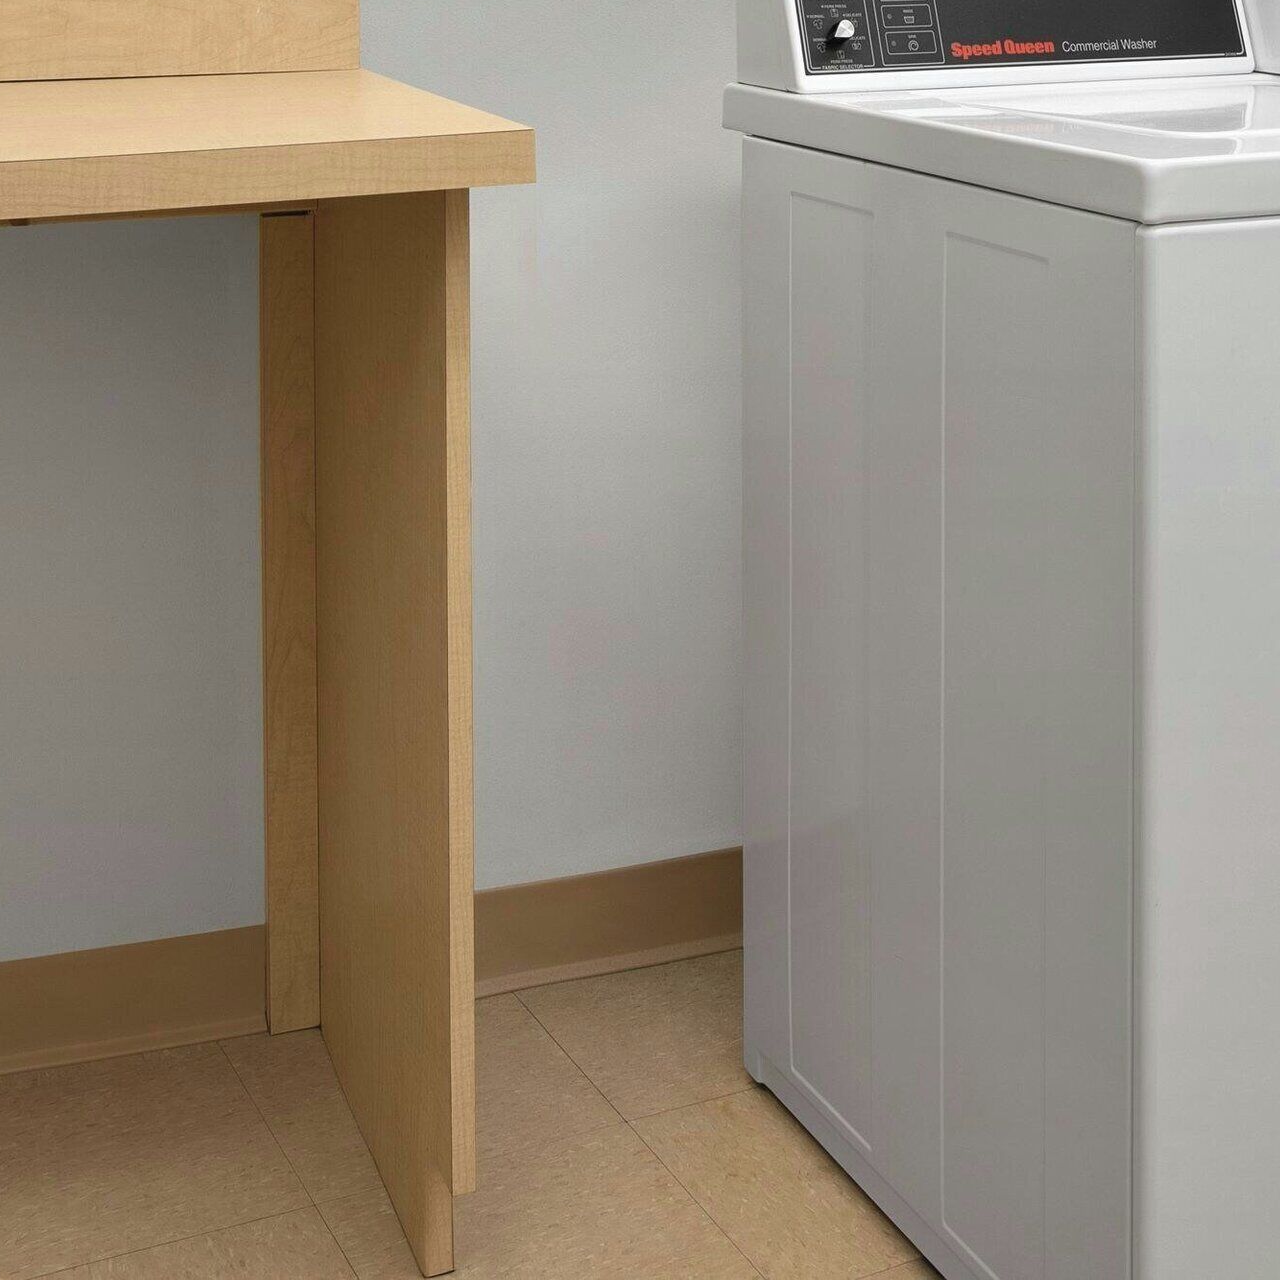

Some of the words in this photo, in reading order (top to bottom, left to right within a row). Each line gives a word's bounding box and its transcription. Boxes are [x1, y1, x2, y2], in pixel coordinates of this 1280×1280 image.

[951, 40, 1002, 60] Speed
[1003, 39, 1055, 54] Queen
[1062, 40, 1120, 52] Commercial
[1120, 38, 1157, 50] Washer
